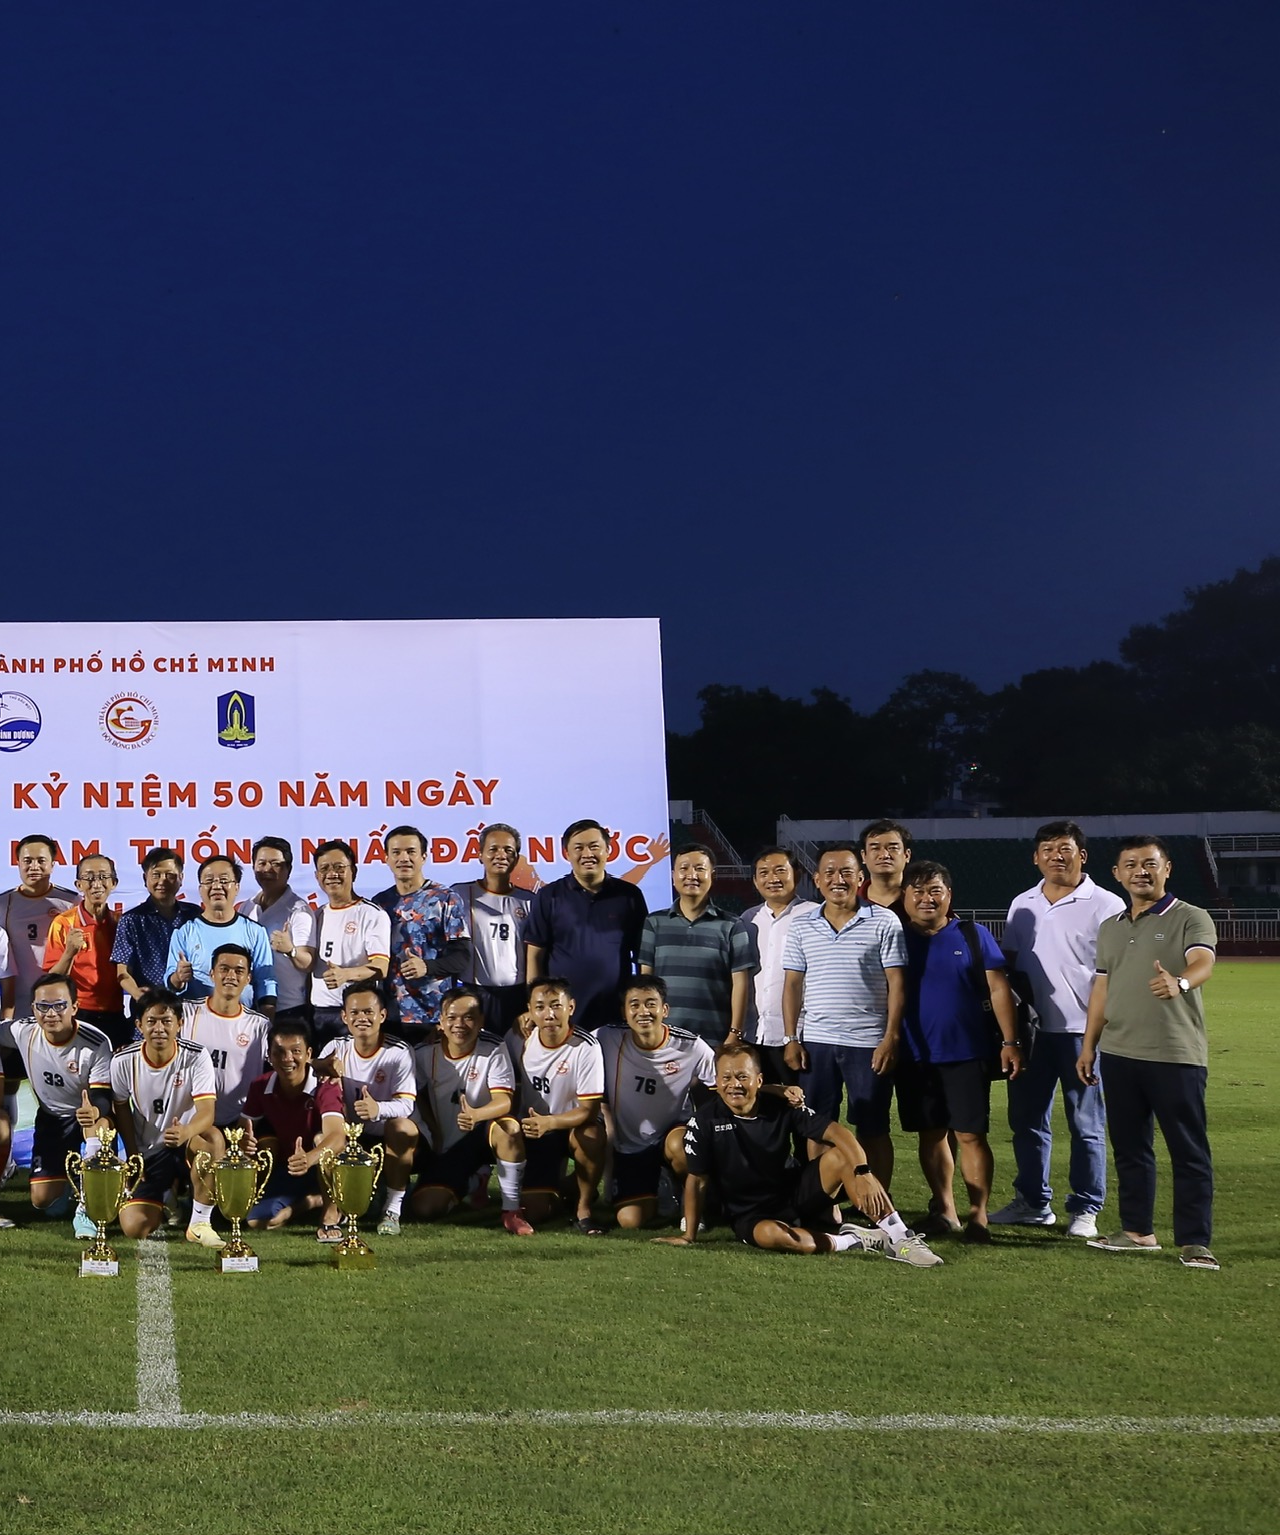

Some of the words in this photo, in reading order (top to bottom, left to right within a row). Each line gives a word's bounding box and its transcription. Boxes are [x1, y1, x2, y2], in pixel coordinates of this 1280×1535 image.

[54, 650, 103, 673] PHỐ
[112, 650, 145, 673] HỒ
[153, 653, 198, 673] CHÍ
[208, 657, 275, 672] MINH
[13, 771, 68, 809] KỶ
[83, 773, 197, 817] NIỆM
[213, 781, 263, 808] 50
[279, 772, 369, 808] NĂM
[385, 771, 499, 807] NGÀY
[27, 924, 38, 940] 3
[489, 922, 509, 941] 78
[324, 941, 334, 958] 5
[43, 1071, 65, 1087] 33
[634, 1075, 657, 1095] 76
[153, 1098, 164, 1115] 8
